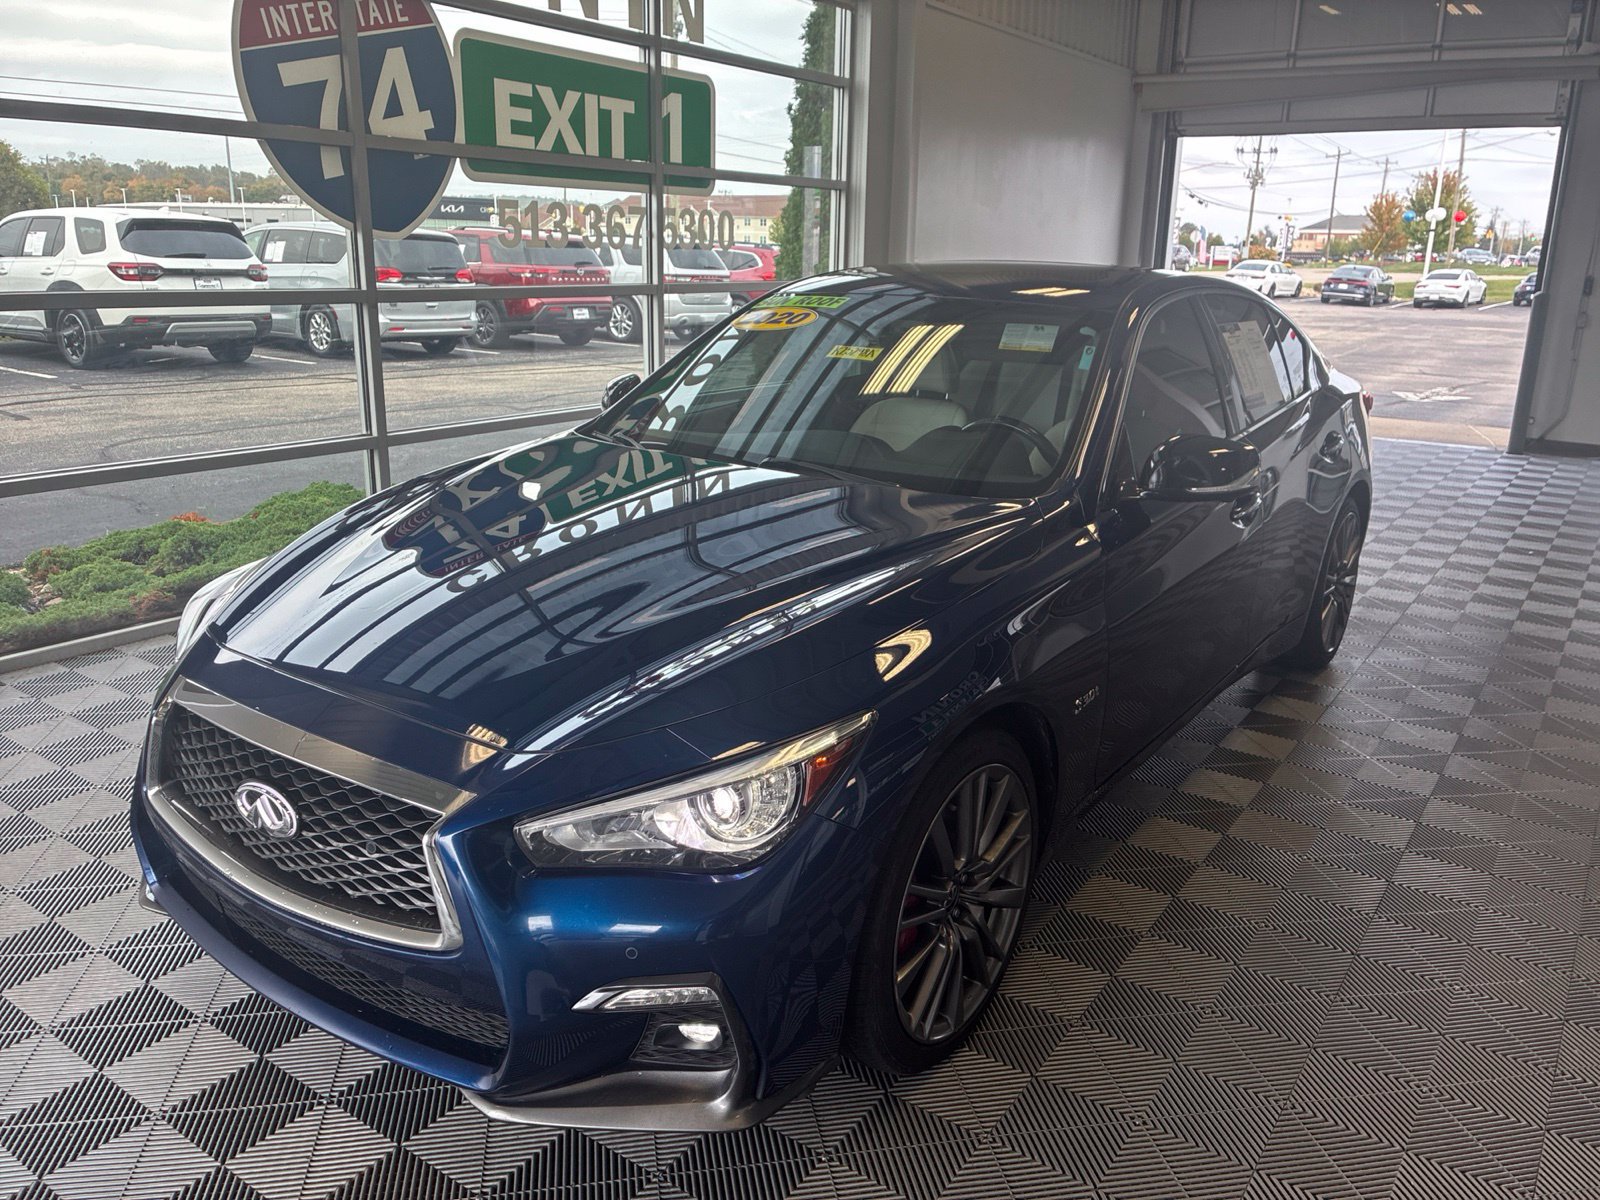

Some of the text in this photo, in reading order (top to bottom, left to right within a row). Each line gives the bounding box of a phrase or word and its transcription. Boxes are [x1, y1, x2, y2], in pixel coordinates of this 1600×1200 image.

[260, 0, 409, 39] INTERTATE
[276, 46, 435, 180] 74
[493, 77, 683, 164] EXIT 1
[498, 200, 735, 251] 513 367 5300
